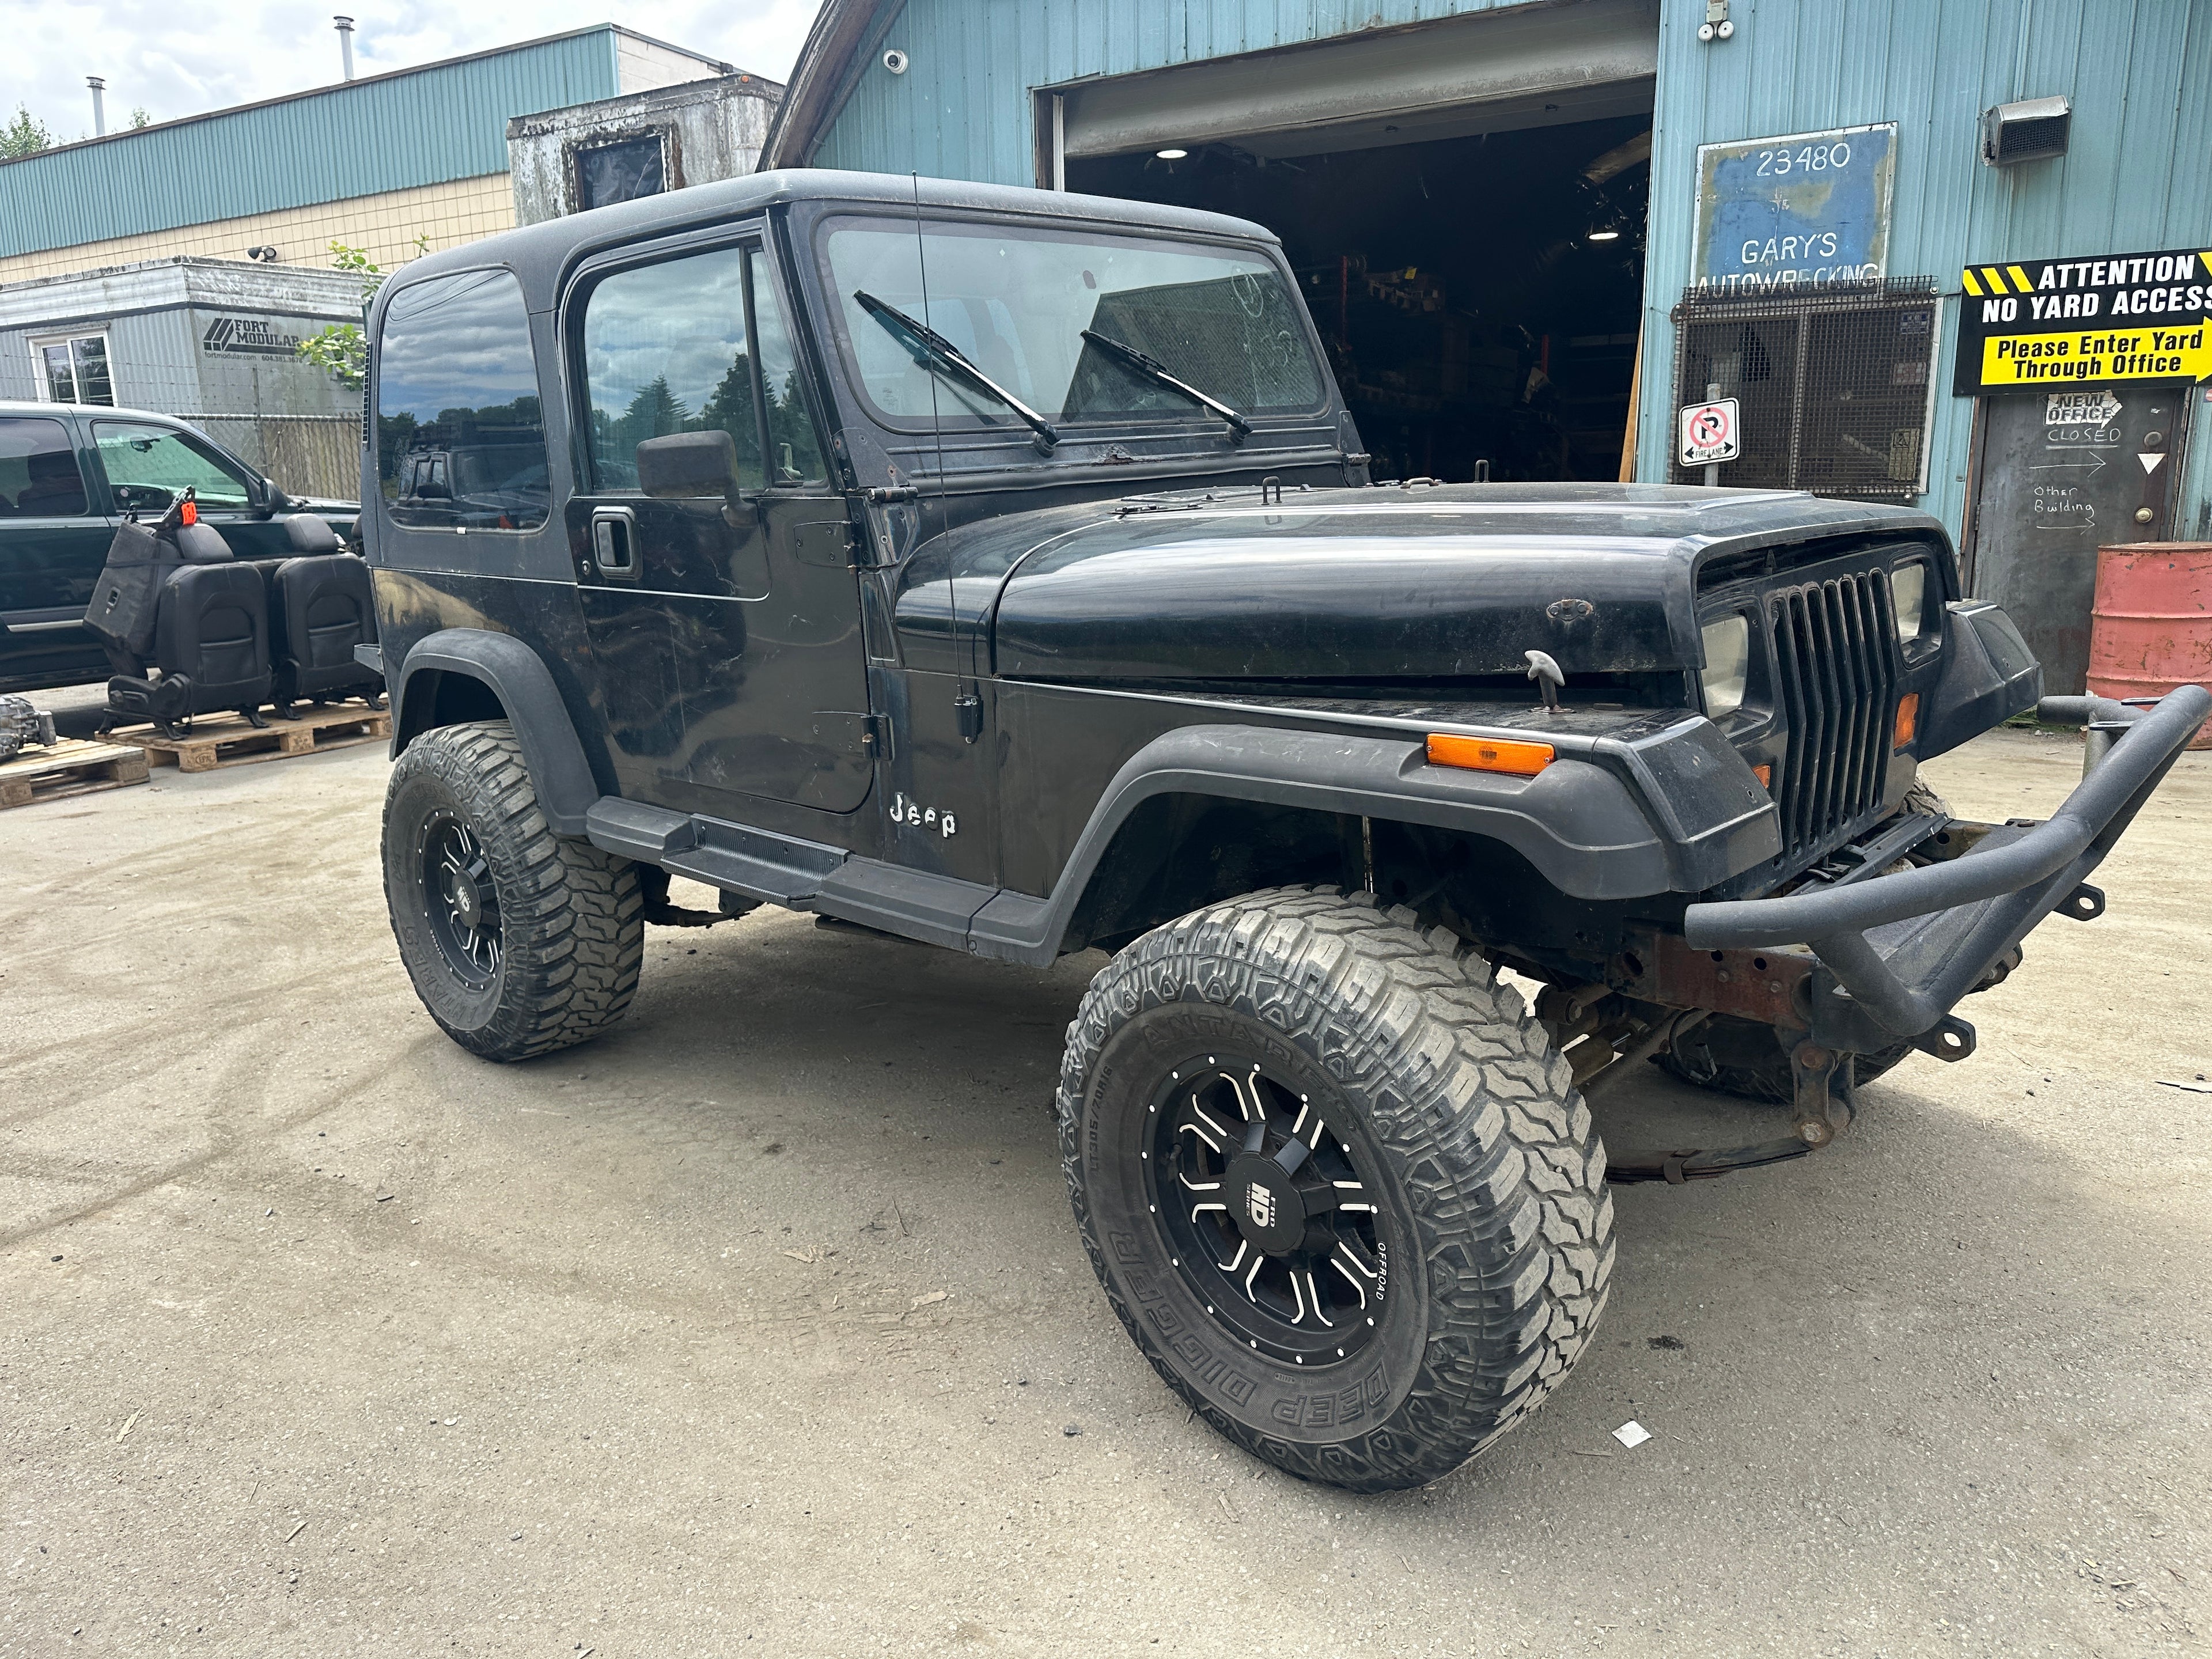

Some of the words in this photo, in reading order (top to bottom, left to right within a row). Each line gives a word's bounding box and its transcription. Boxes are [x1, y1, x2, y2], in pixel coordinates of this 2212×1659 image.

[1756, 142, 1851, 177] 23480
[1741, 232, 1838, 264] GARY'S
[2037, 254, 2195, 290] ATTENTION
[1982, 297, 2018, 323] NO
[2031, 293, 2100, 320] YARD
[234, 319, 269, 334] FORT
[236, 332, 301, 346] MODULAR
[204, 352, 257, 361] fortmodular.com
[1997, 340, 2069, 359] Please
[2080, 334, 2141, 355] Enter
[2153, 329, 2204, 351] Yard
[2014, 357, 2102, 379] Through
[2112, 354, 2182, 374] Office
[2048, 407, 2112, 421] OFFICE
[2059, 394, 2104, 408] NEW
[2047, 428, 2121, 442] CLOSED
[1695, 449, 1707, 458] FIRE
[2034, 499, 2094, 519] Building
[889, 792, 957, 839] Jeep
[1251, 1181, 1270, 1228] HD
[1376, 1242, 1388, 1301] OFFROAD
[1108, 1230, 1258, 1407] DIGGER
[1271, 1361, 1391, 1428] DEEP
